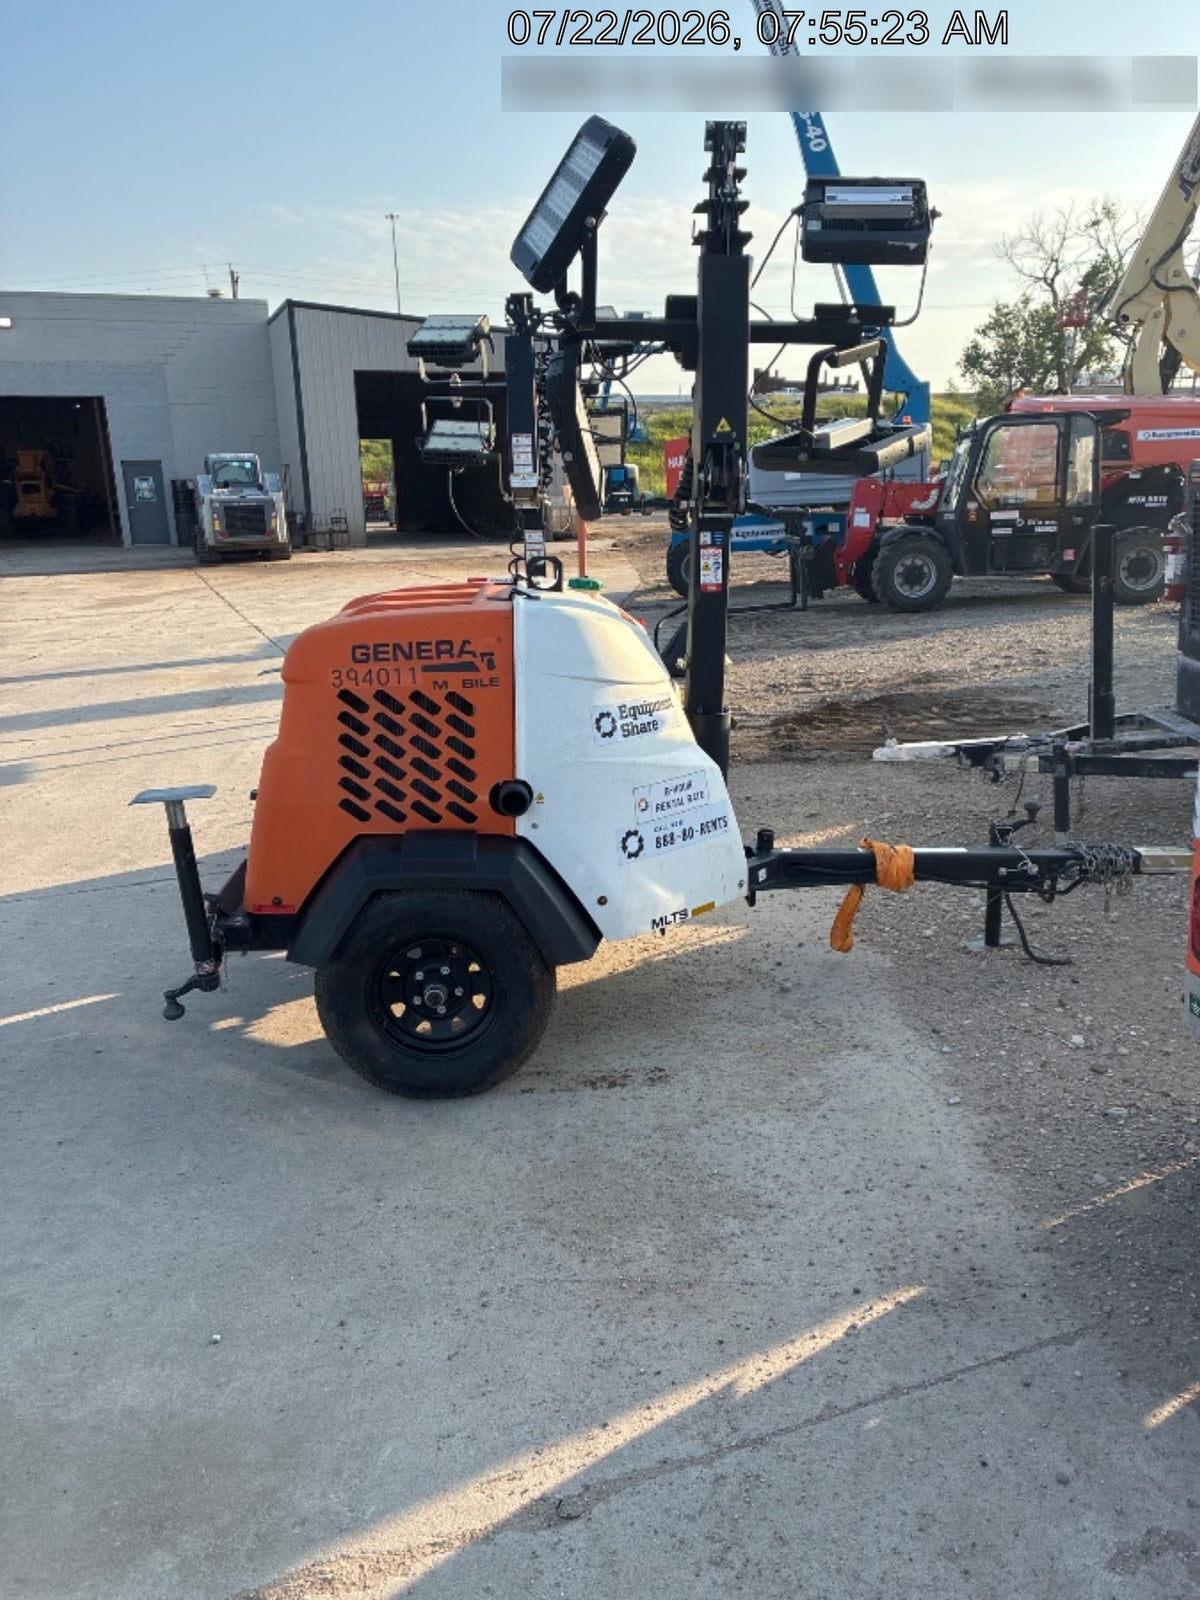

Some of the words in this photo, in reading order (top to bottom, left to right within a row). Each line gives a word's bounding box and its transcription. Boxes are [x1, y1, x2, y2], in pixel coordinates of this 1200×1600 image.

[331, 666, 417, 690] 394011
[432, 676, 501, 691] MBILE
[621, 719, 659, 738] Share
